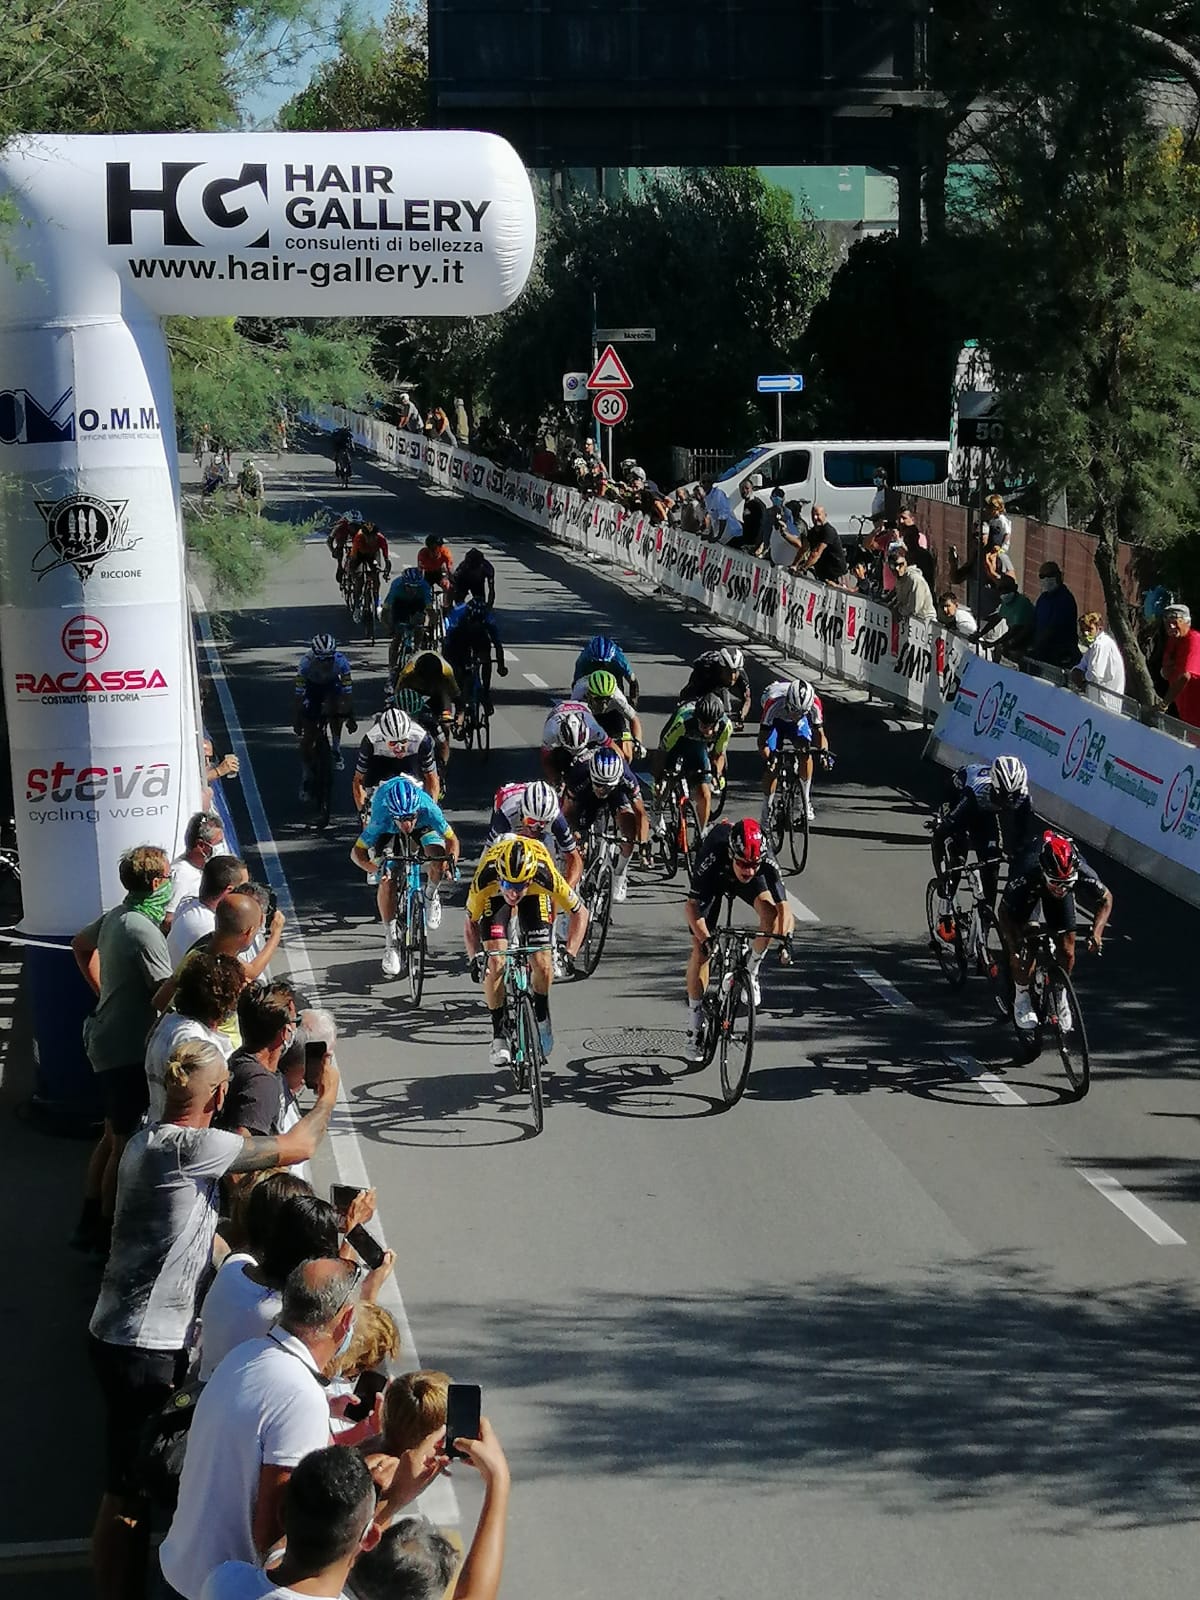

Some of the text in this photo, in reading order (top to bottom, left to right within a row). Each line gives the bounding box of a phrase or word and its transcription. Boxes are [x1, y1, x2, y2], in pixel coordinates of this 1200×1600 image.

[284, 164, 395, 194] HAIR
[285, 196, 492, 233] GALLERY
[285, 236, 484, 253] consulenti di bellezza
[128, 254, 465, 289] www.hair-gallery.it
[601, 398, 620, 415] 30
[975, 422, 1003, 440] 50
[100, 569, 142, 579] RICCIONE
[727, 575, 751, 603] SMP
[814, 611, 843, 647] SMP
[857, 607, 888, 628] SELLE
[851, 626, 888, 664] SMP
[900, 622, 933, 646] SELLE
[894, 641, 932, 683] SMP
[15, 668, 169, 694] RACASSA
[41, 693, 140, 705] COSTRUTTORI DI STORIA
[1086, 731, 1106, 762] ER
[26, 761, 171, 803] steva
[1188, 780, 1200, 812] E
[29, 804, 169, 825] cycling wear
